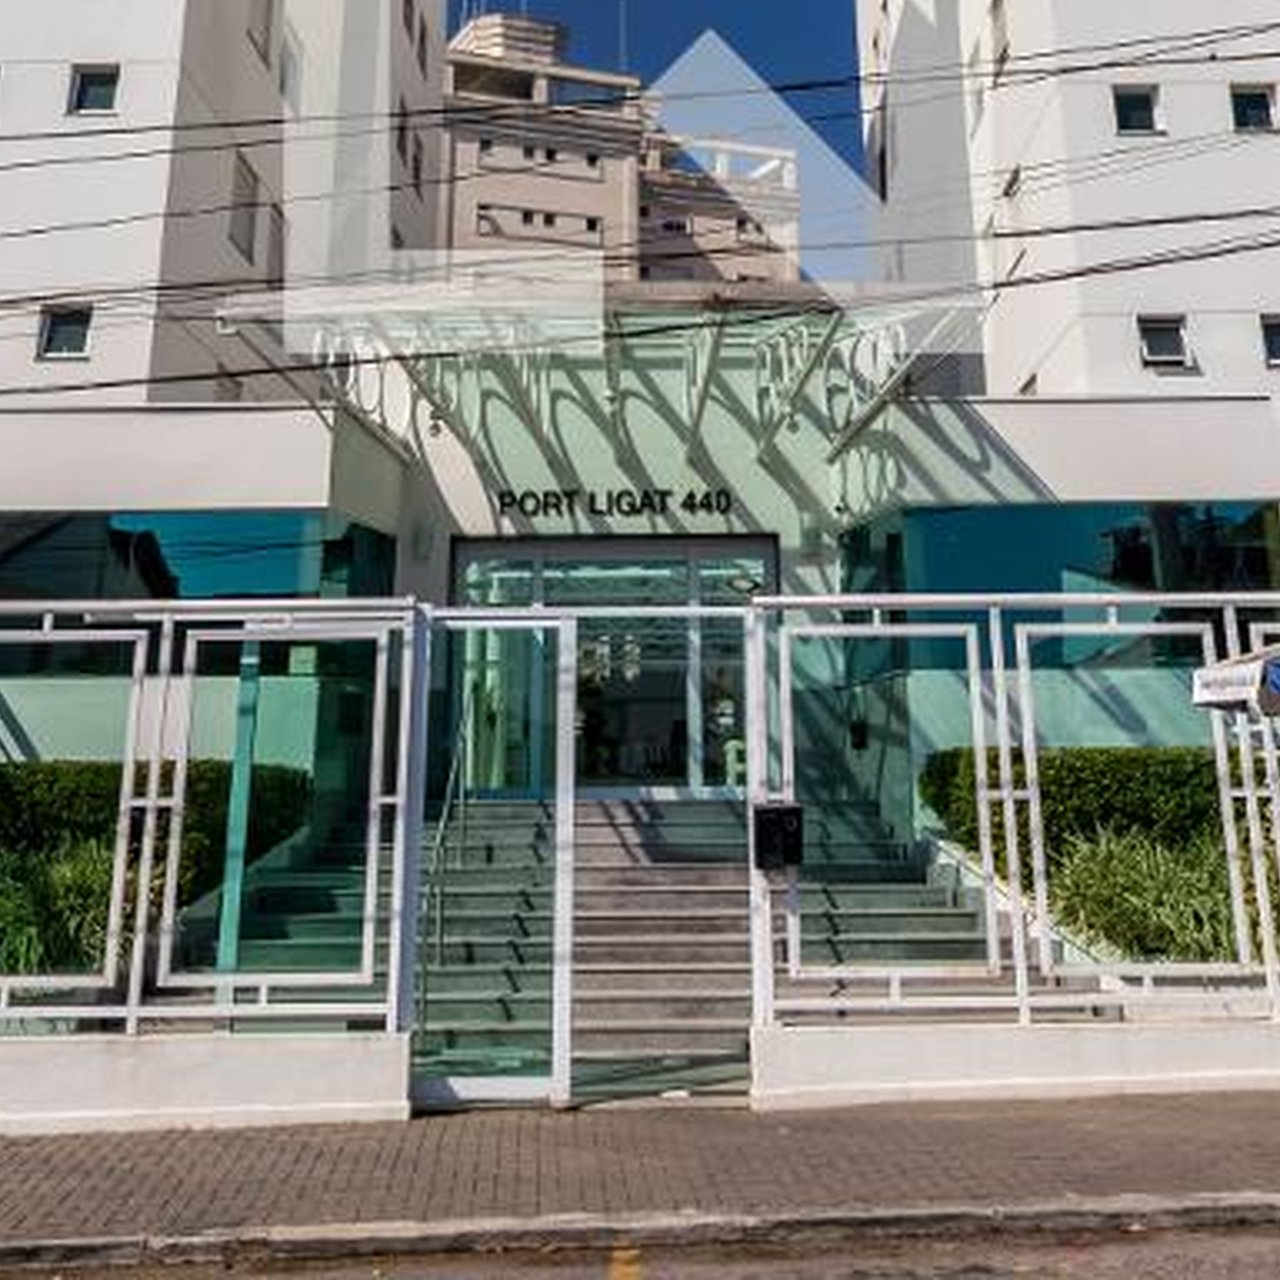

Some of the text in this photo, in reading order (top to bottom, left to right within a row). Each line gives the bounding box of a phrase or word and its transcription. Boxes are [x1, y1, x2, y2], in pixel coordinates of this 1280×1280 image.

[498, 488, 732, 516] PORT LIGAT 440
